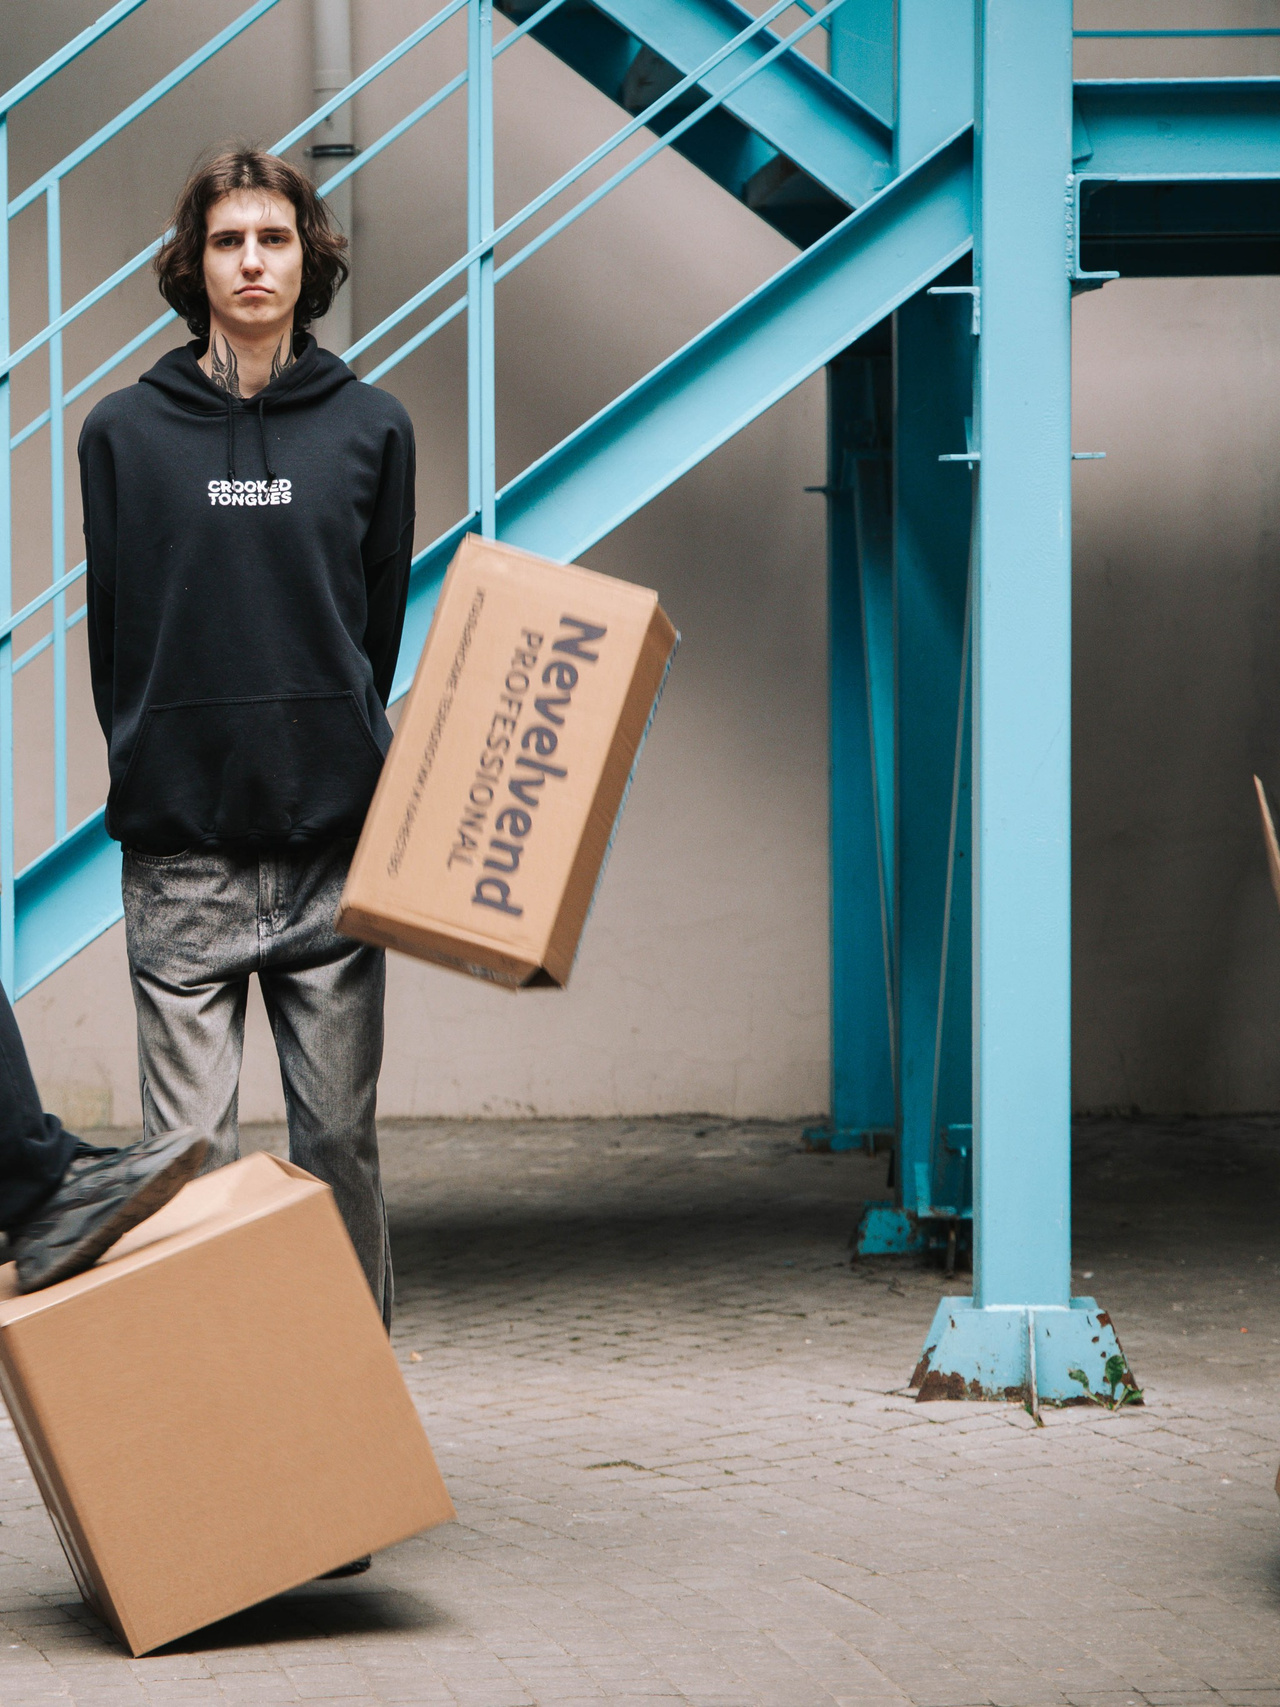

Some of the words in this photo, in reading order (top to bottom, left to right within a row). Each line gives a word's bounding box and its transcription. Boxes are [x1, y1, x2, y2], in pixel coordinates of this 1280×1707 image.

[207, 479, 292, 493] CROOKED
[207, 491, 292, 506] TONGUES
[446, 628, 544, 870] PROFESSIONAL
[471, 611, 608, 917] Nevelvend
